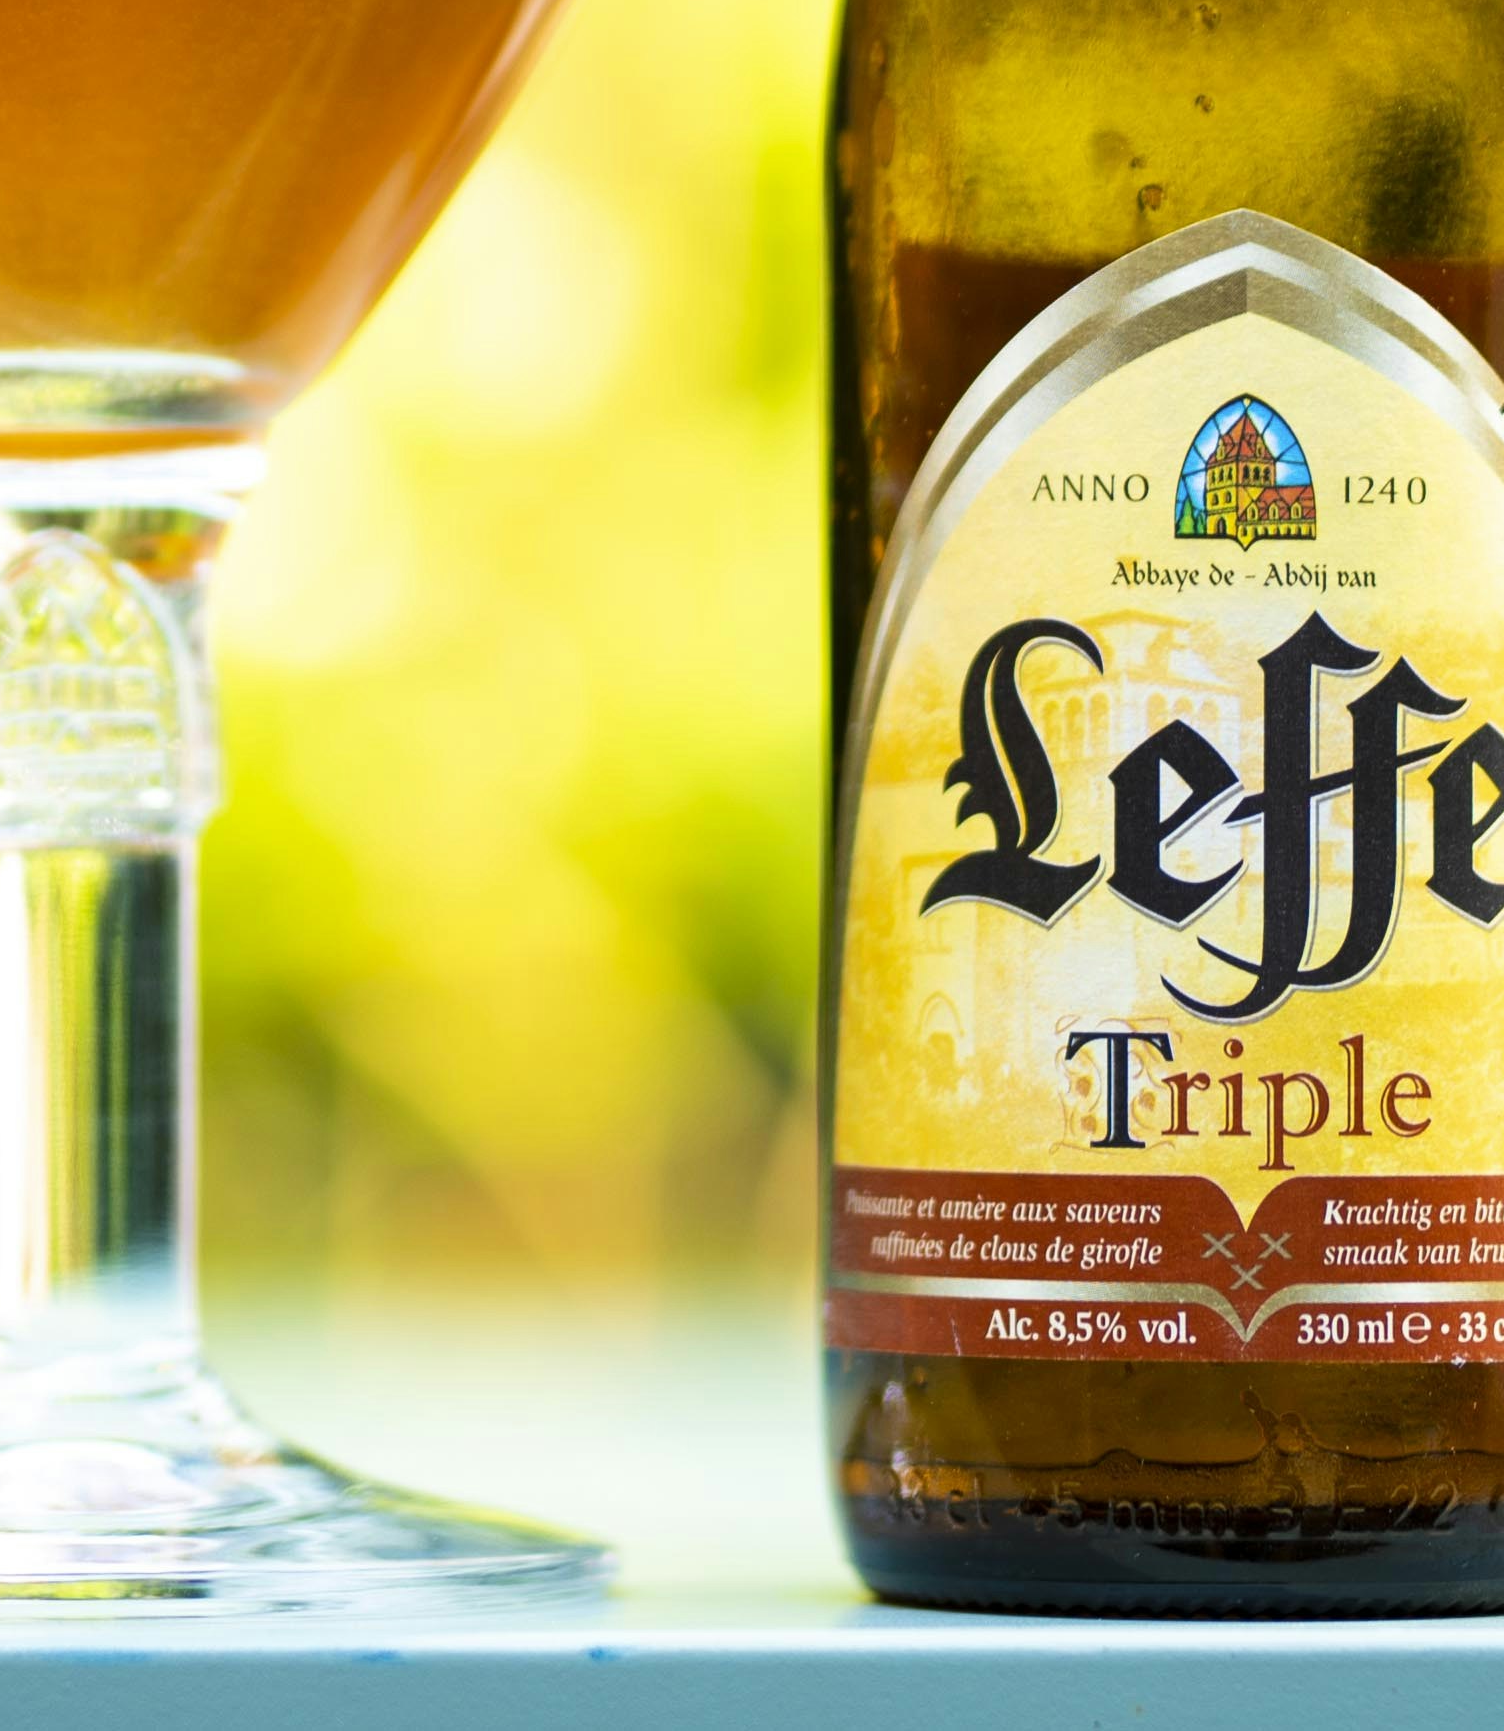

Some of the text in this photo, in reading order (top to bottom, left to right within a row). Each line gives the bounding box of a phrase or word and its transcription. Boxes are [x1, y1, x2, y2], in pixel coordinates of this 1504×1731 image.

[1031, 473, 1150, 504] ANNO
[1343, 475, 1428, 506] 1240
[1110, 560, 1201, 594] Abbaye
[1208, 560, 1236, 587] de
[1263, 561, 1328, 594] Abdij
[1337, 567, 1378, 589] van
[1064, 1029, 1435, 1172] Triple
[916, 1195, 936, 1218] et
[940, 1194, 1006, 1223] amère
[1012, 1202, 1058, 1224] aux
[1065, 1202, 1163, 1225] saveurs
[1323, 1198, 1433, 1231] Krachtig
[1439, 1204, 1467, 1225] en
[871, 1230, 1164, 1270] raffinées de clous de girofle
[1323, 1238, 1410, 1266] smaak
[1415, 1244, 1462, 1265] van
[984, 1308, 1198, 1346] Alc. 8,5% vol.
[1297, 1313, 1350, 1345] 330
[1457, 1312, 1488, 1344] 33
